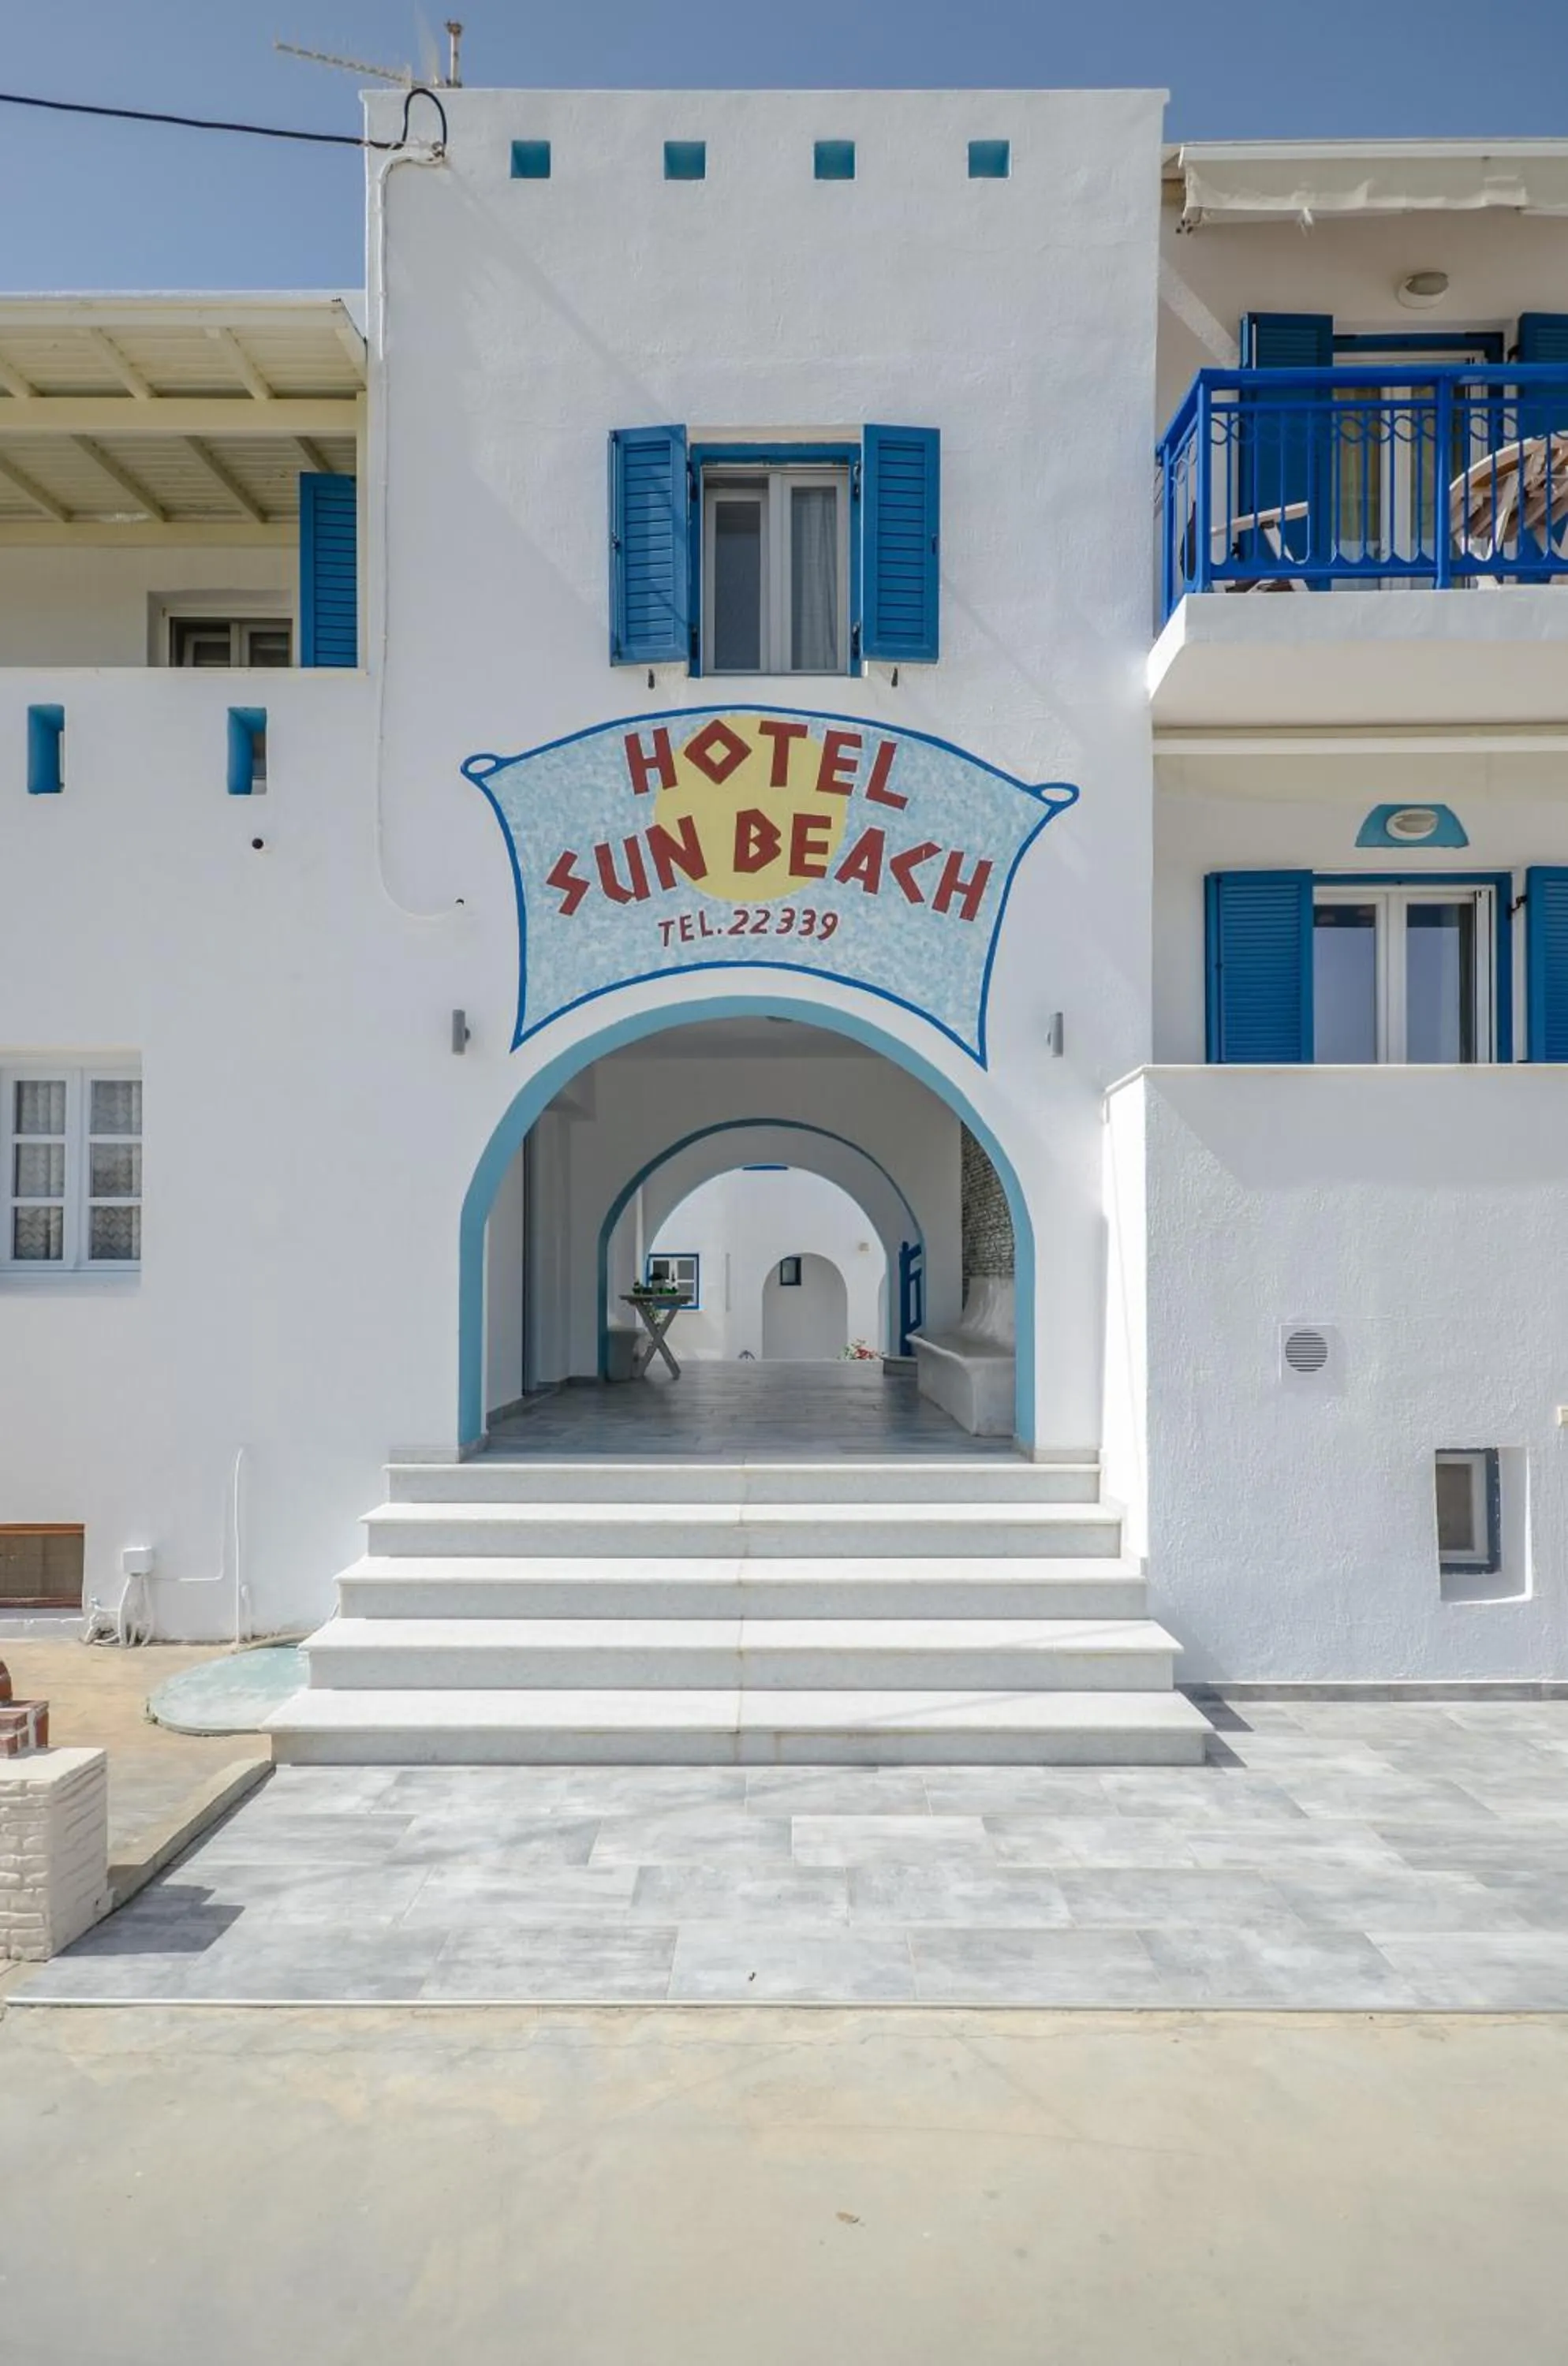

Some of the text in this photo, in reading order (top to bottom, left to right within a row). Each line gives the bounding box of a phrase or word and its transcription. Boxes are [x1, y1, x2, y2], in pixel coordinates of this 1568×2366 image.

[624, 719, 909, 809] HOTEL
[547, 809, 993, 921] SUN BEACH
